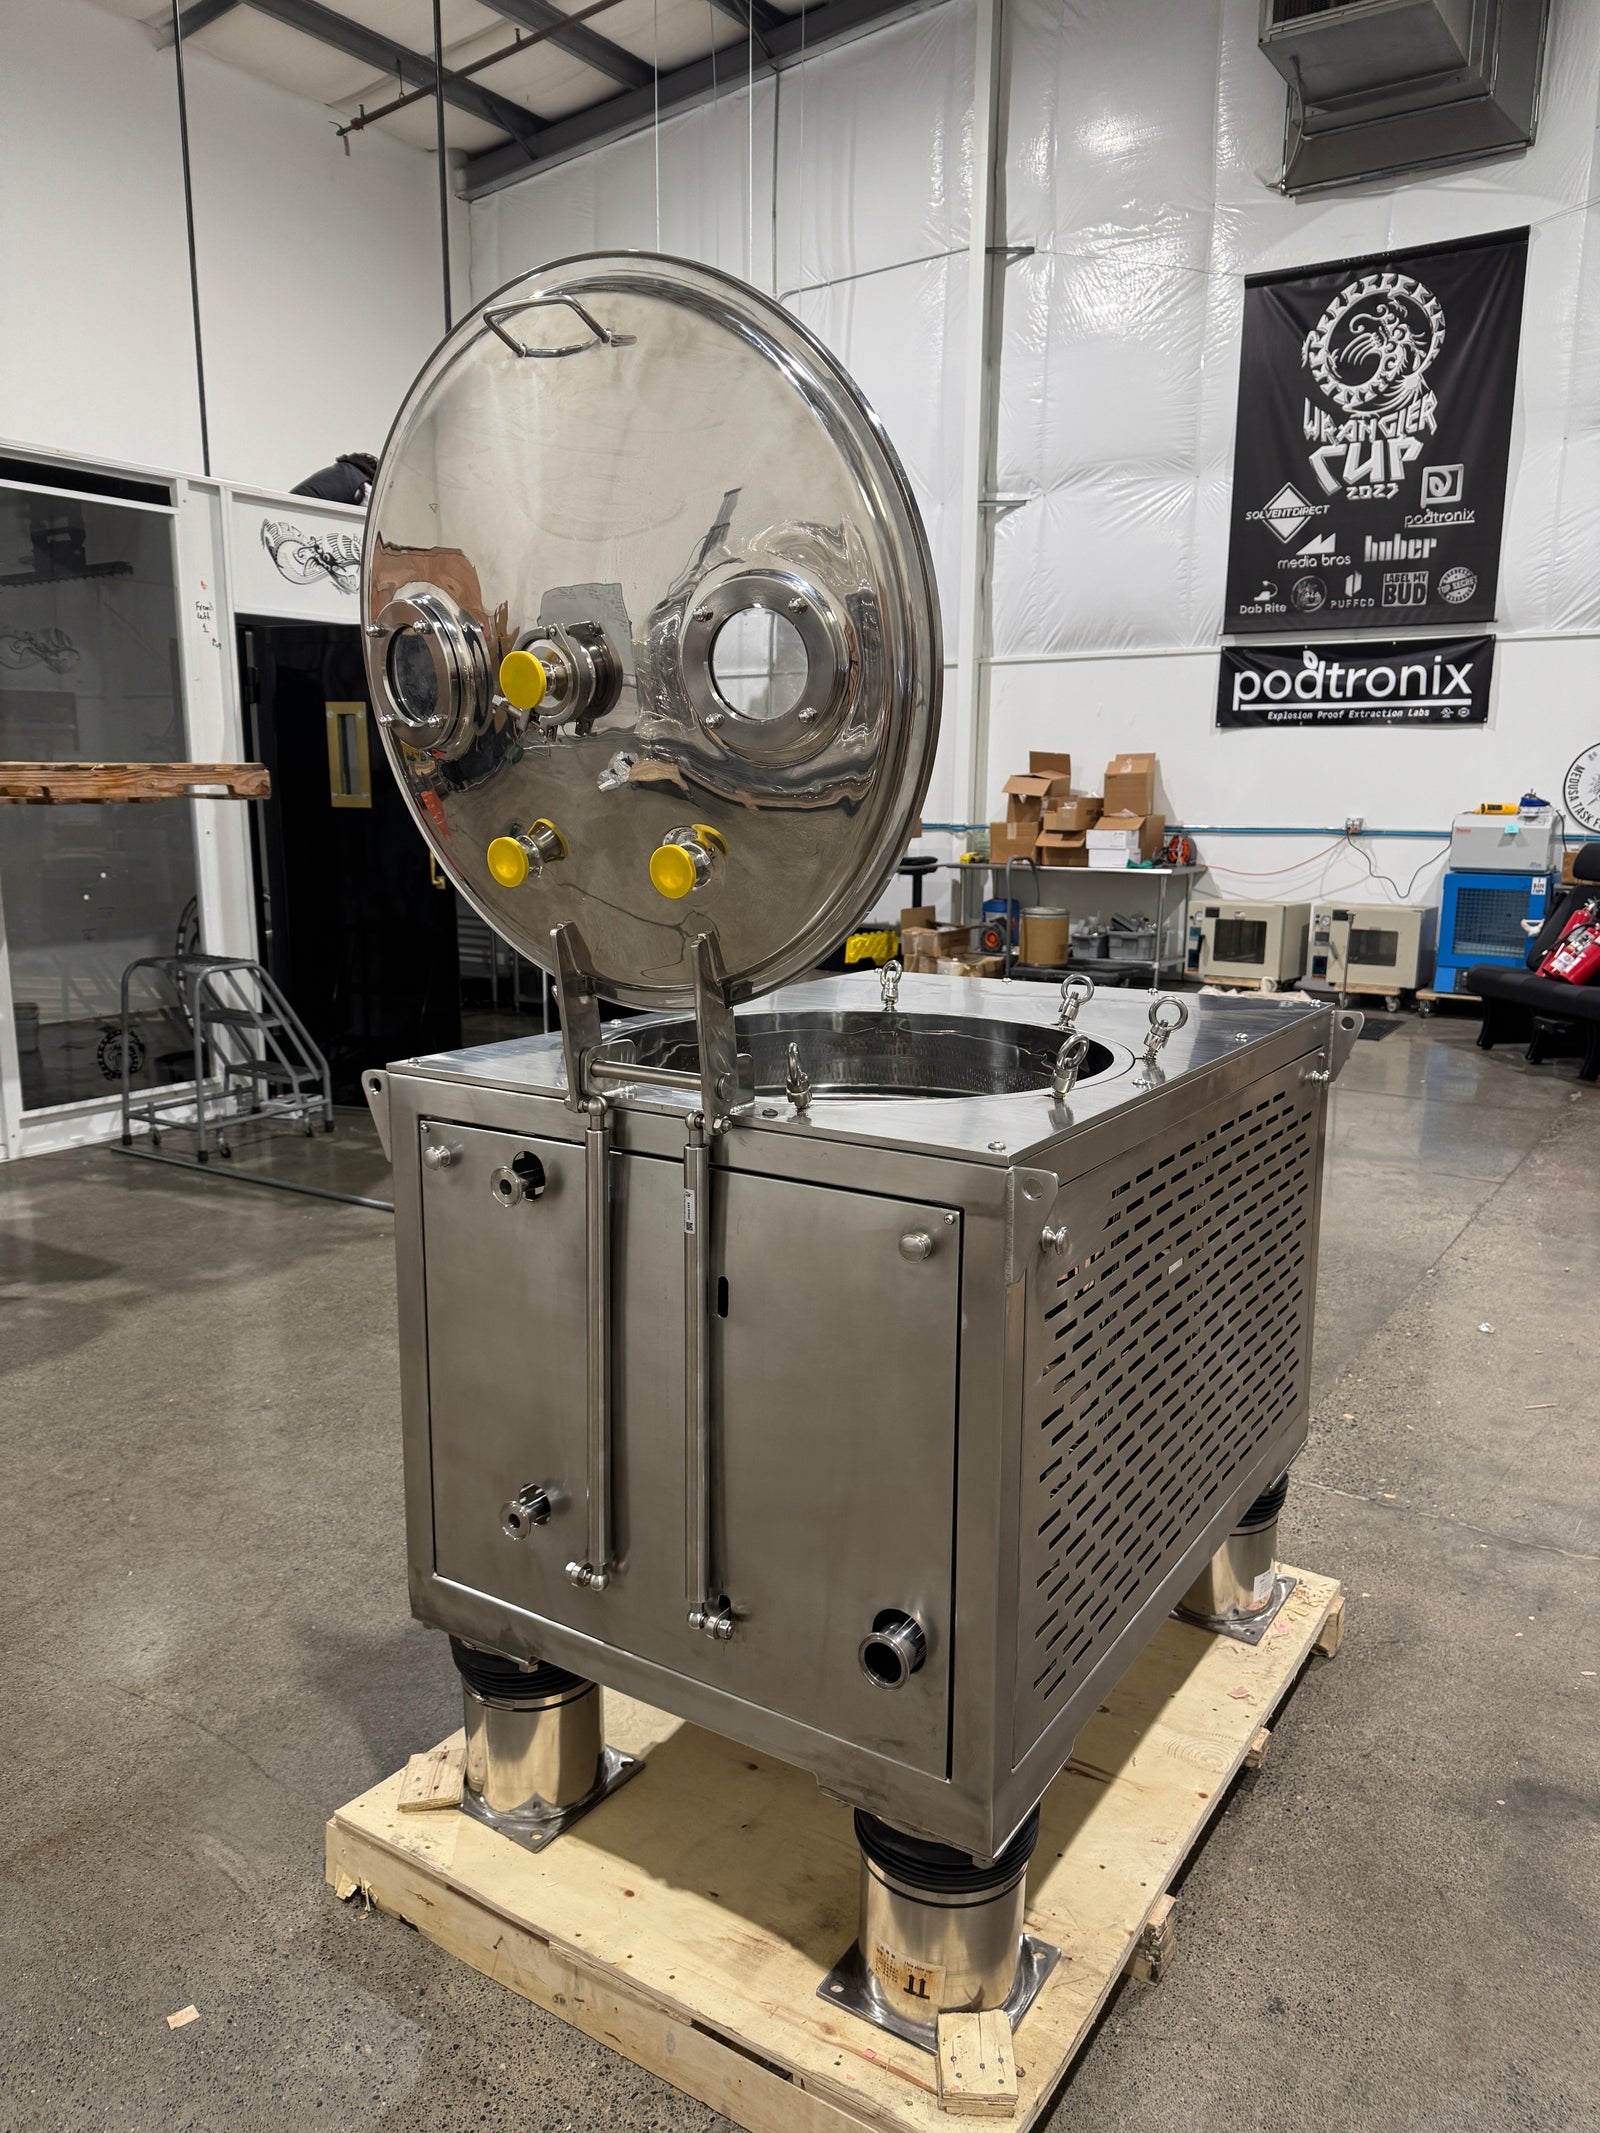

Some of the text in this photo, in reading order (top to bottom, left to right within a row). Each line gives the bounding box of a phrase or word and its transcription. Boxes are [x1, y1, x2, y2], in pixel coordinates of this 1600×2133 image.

[1303, 389, 1438, 445] WRANGLER
[1309, 437, 1424, 496] CUP
[1346, 482, 1399, 500] 2023
[1245, 504, 1331, 520] SOLVENTDIRECT
[1404, 508, 1476, 528] podtronix
[1364, 533, 1437, 562] huber
[1277, 553, 1352, 569] media bros
[1384, 572, 1427, 583] LABEL MY
[1384, 582, 1426, 605] BUD
[1239, 602, 1288, 614] Dab Rite
[1232, 650, 1474, 711] podtronix
[1267, 709, 1313, 720] Explosion
[1317, 709, 1344, 719] Proof
[1348, 708, 1404, 719] Extraction
[1408, 707, 1431, 718] Labs
[1567, 763, 1586, 802] MEDUSA
[1572, 801, 1594, 824] TASK
